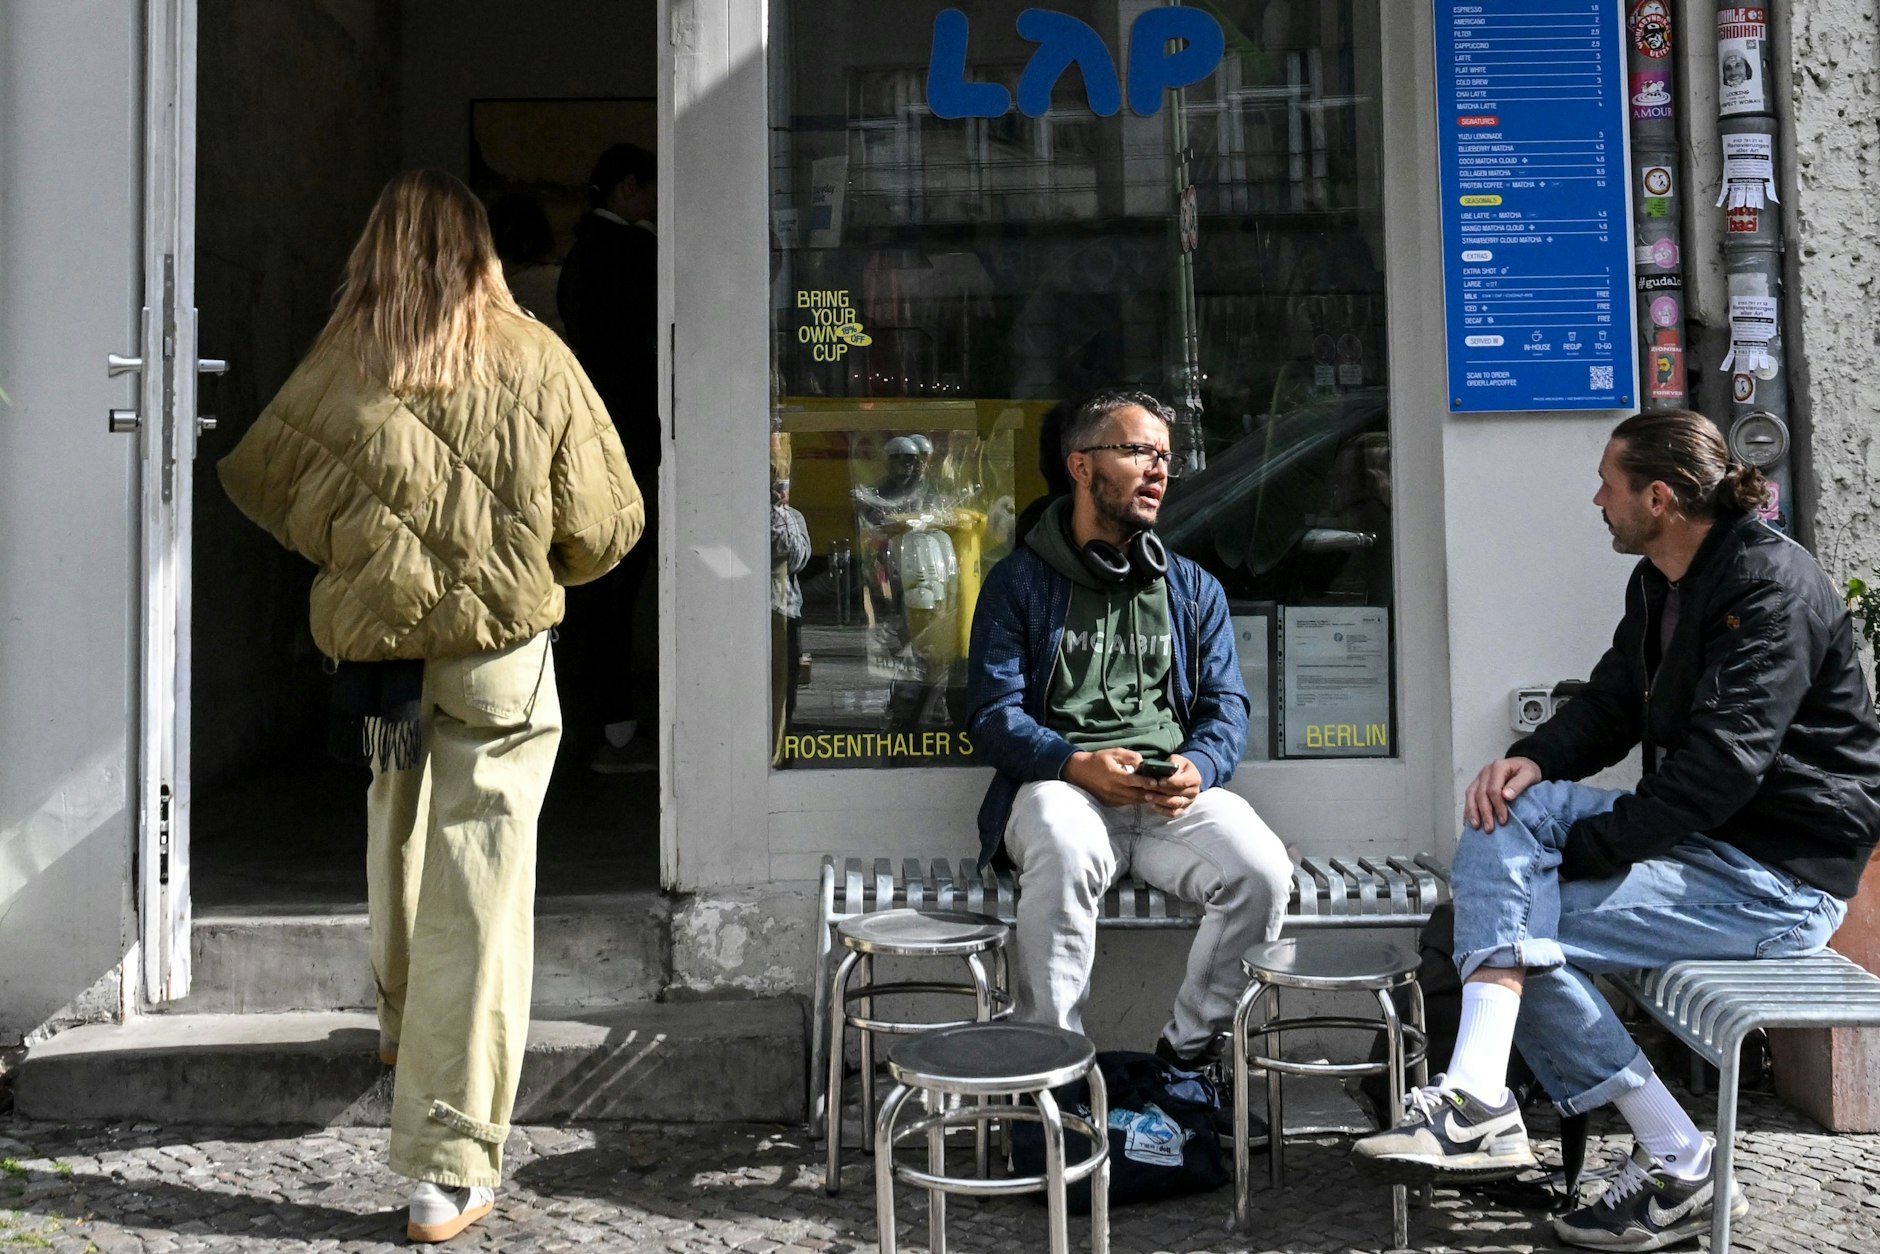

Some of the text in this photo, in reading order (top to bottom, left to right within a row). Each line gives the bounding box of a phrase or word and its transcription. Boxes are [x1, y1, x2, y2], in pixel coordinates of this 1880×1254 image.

[1633, 108, 1672, 118] AMOUR
[798, 290, 849, 308] BRING
[811, 308, 856, 325] YOUR
[798, 326, 838, 343] OWN
[813, 344, 848, 362] CUP
[1306, 724, 1386, 747] BERLIN
[784, 732, 950, 759] ROSENTHALER
